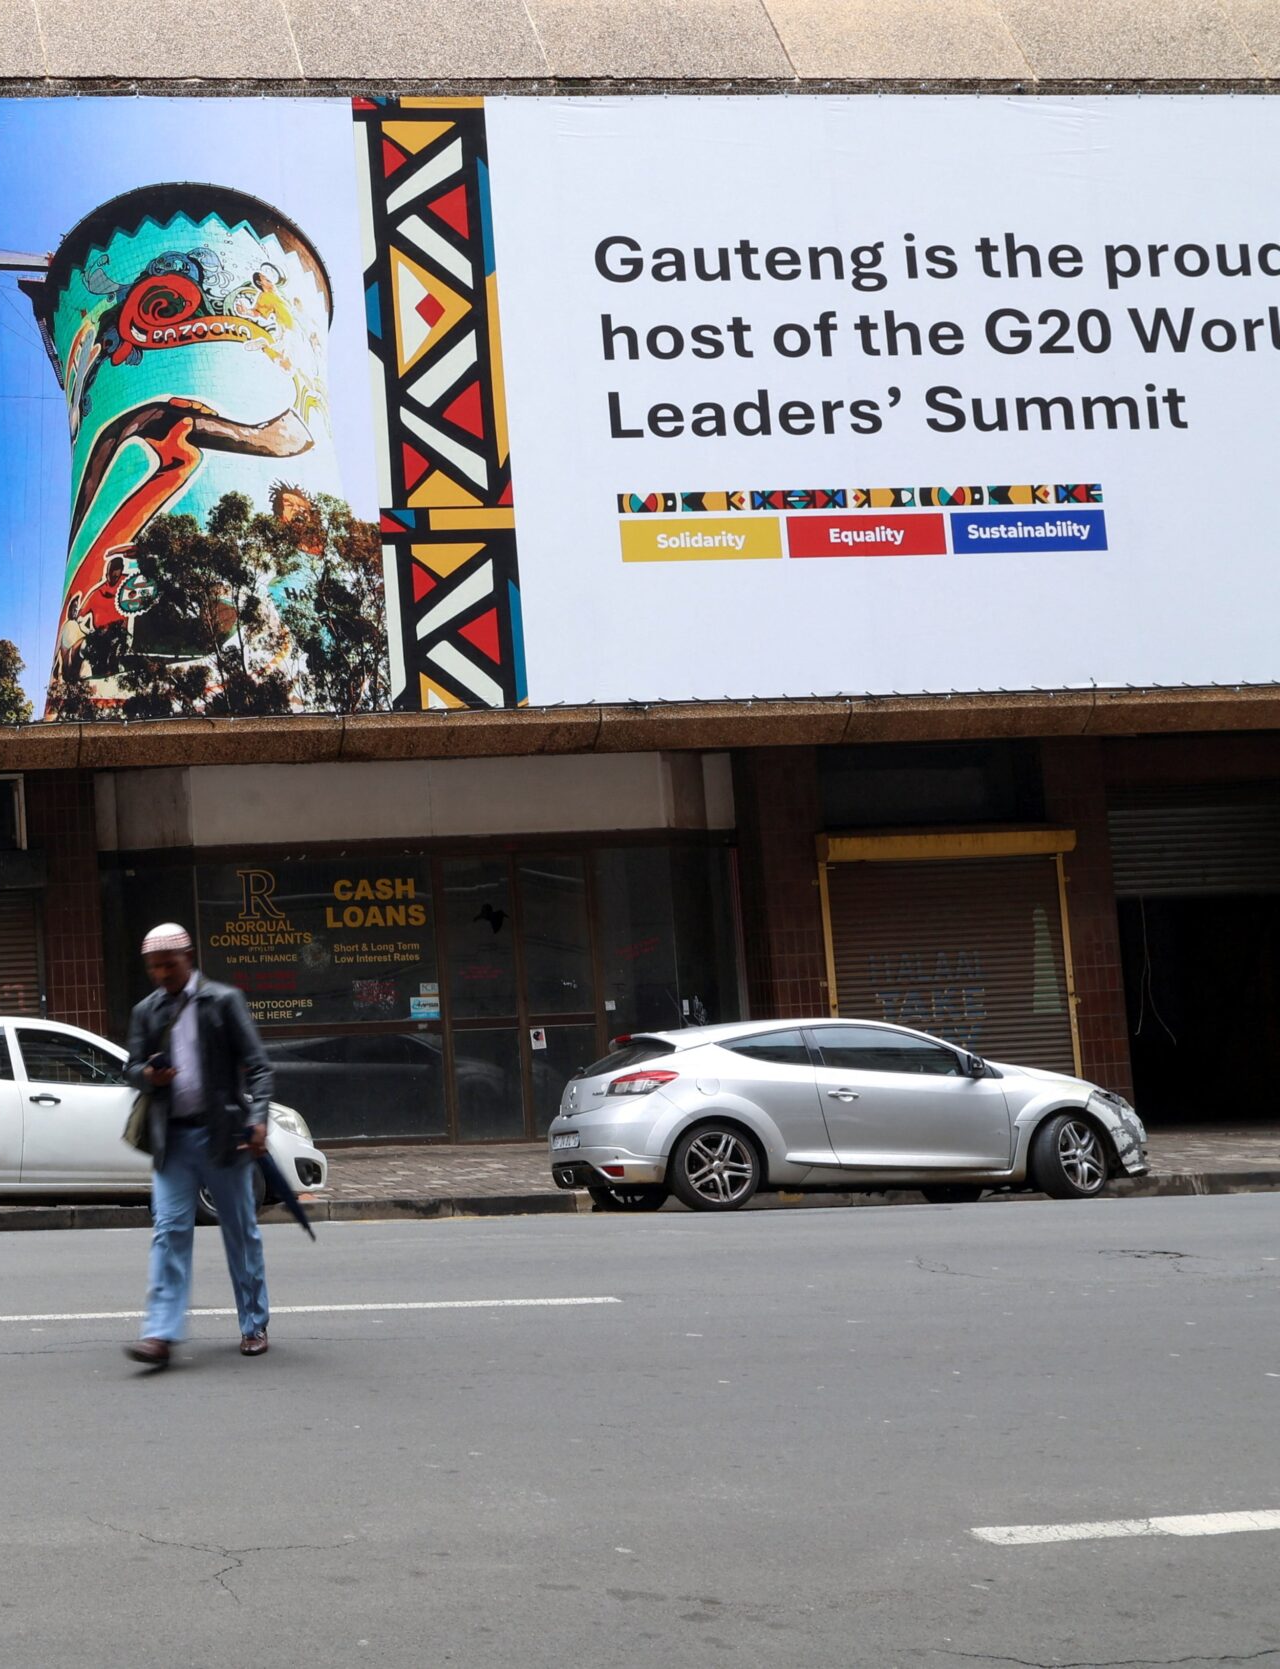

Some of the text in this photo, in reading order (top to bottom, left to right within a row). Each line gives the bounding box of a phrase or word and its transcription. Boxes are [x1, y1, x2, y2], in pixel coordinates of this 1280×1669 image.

[595, 235, 887, 292] Gauteng
[904, 232, 958, 280] is
[975, 232, 1084, 279] the
[152, 321, 252, 345] BAZOOKA
[600, 314, 754, 361] host
[774, 310, 838, 358] of
[854, 309, 965, 357] the
[986, 308, 1112, 355] G20
[608, 383, 1189, 439] Leaders’ Summit
[656, 530, 746, 551] Solidarity
[828, 525, 905, 547] Equality
[967, 520, 1091, 540] Sustainability
[236, 869, 286, 919] R
[333, 877, 416, 902] CASH
[225, 920, 295, 933] RORQUAL
[325, 903, 427, 929] LOANS
[209, 932, 313, 947] CONSULTANTS
[333, 941, 420, 954] Short & Long Term
[239, 955, 258, 964] PILL
[259, 953, 298, 963] FINANCE
[334, 952, 421, 964] Low Interest Rates
[247, 999, 313, 1010] PHOTOCOPIES
[267, 1010, 293, 1020] HERE
[875, 987, 988, 1022] TAKE
